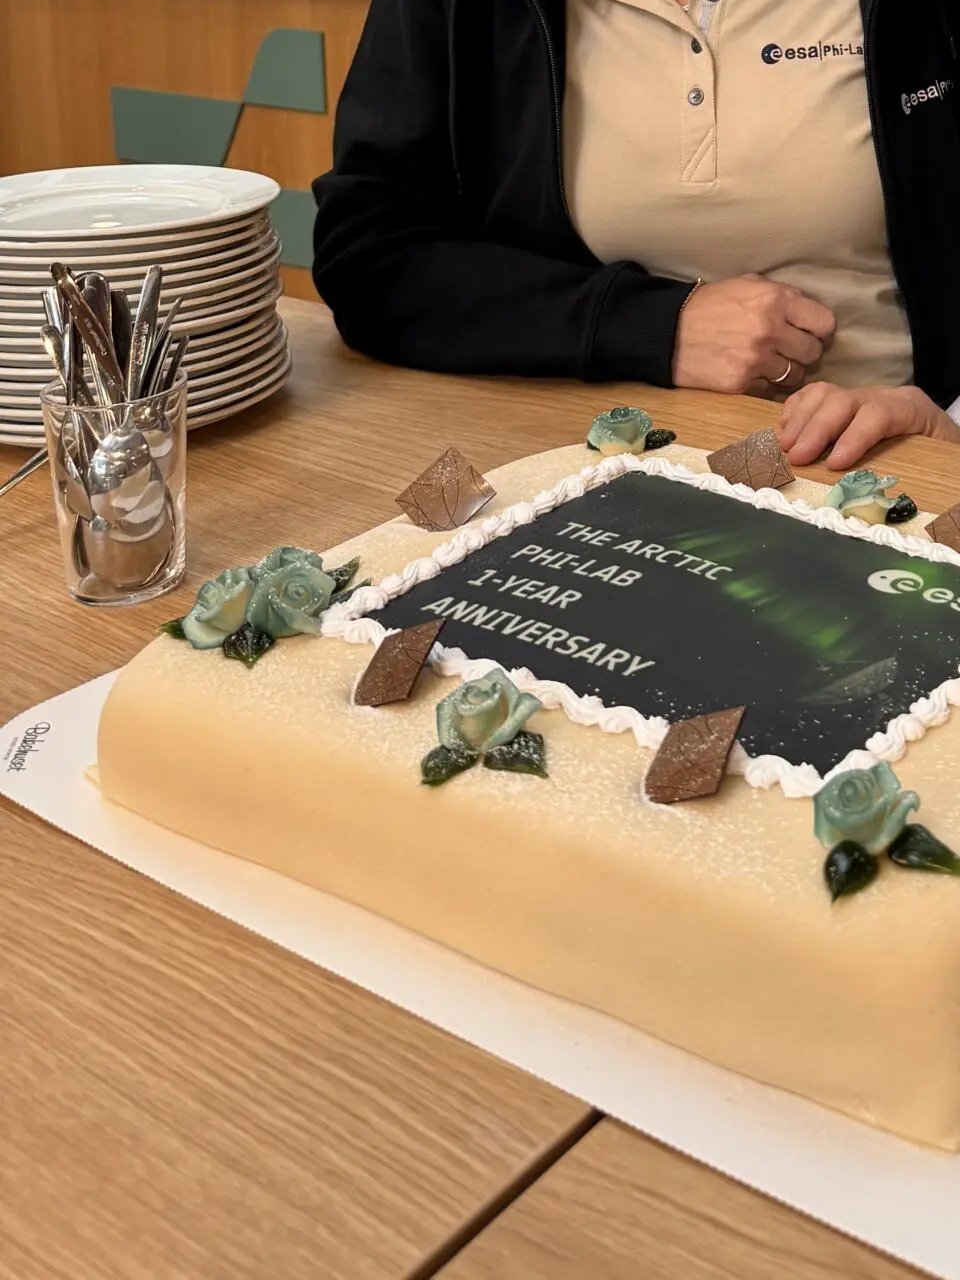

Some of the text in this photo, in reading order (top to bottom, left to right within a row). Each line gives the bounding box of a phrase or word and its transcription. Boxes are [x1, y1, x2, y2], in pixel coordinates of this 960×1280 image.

[511, 544, 643, 588] PHI-LAB
[556, 521, 734, 581] THE ARCTIC
[467, 569, 583, 610] 1-YEAR
[420, 596, 655, 677] ANNIVERSARY
